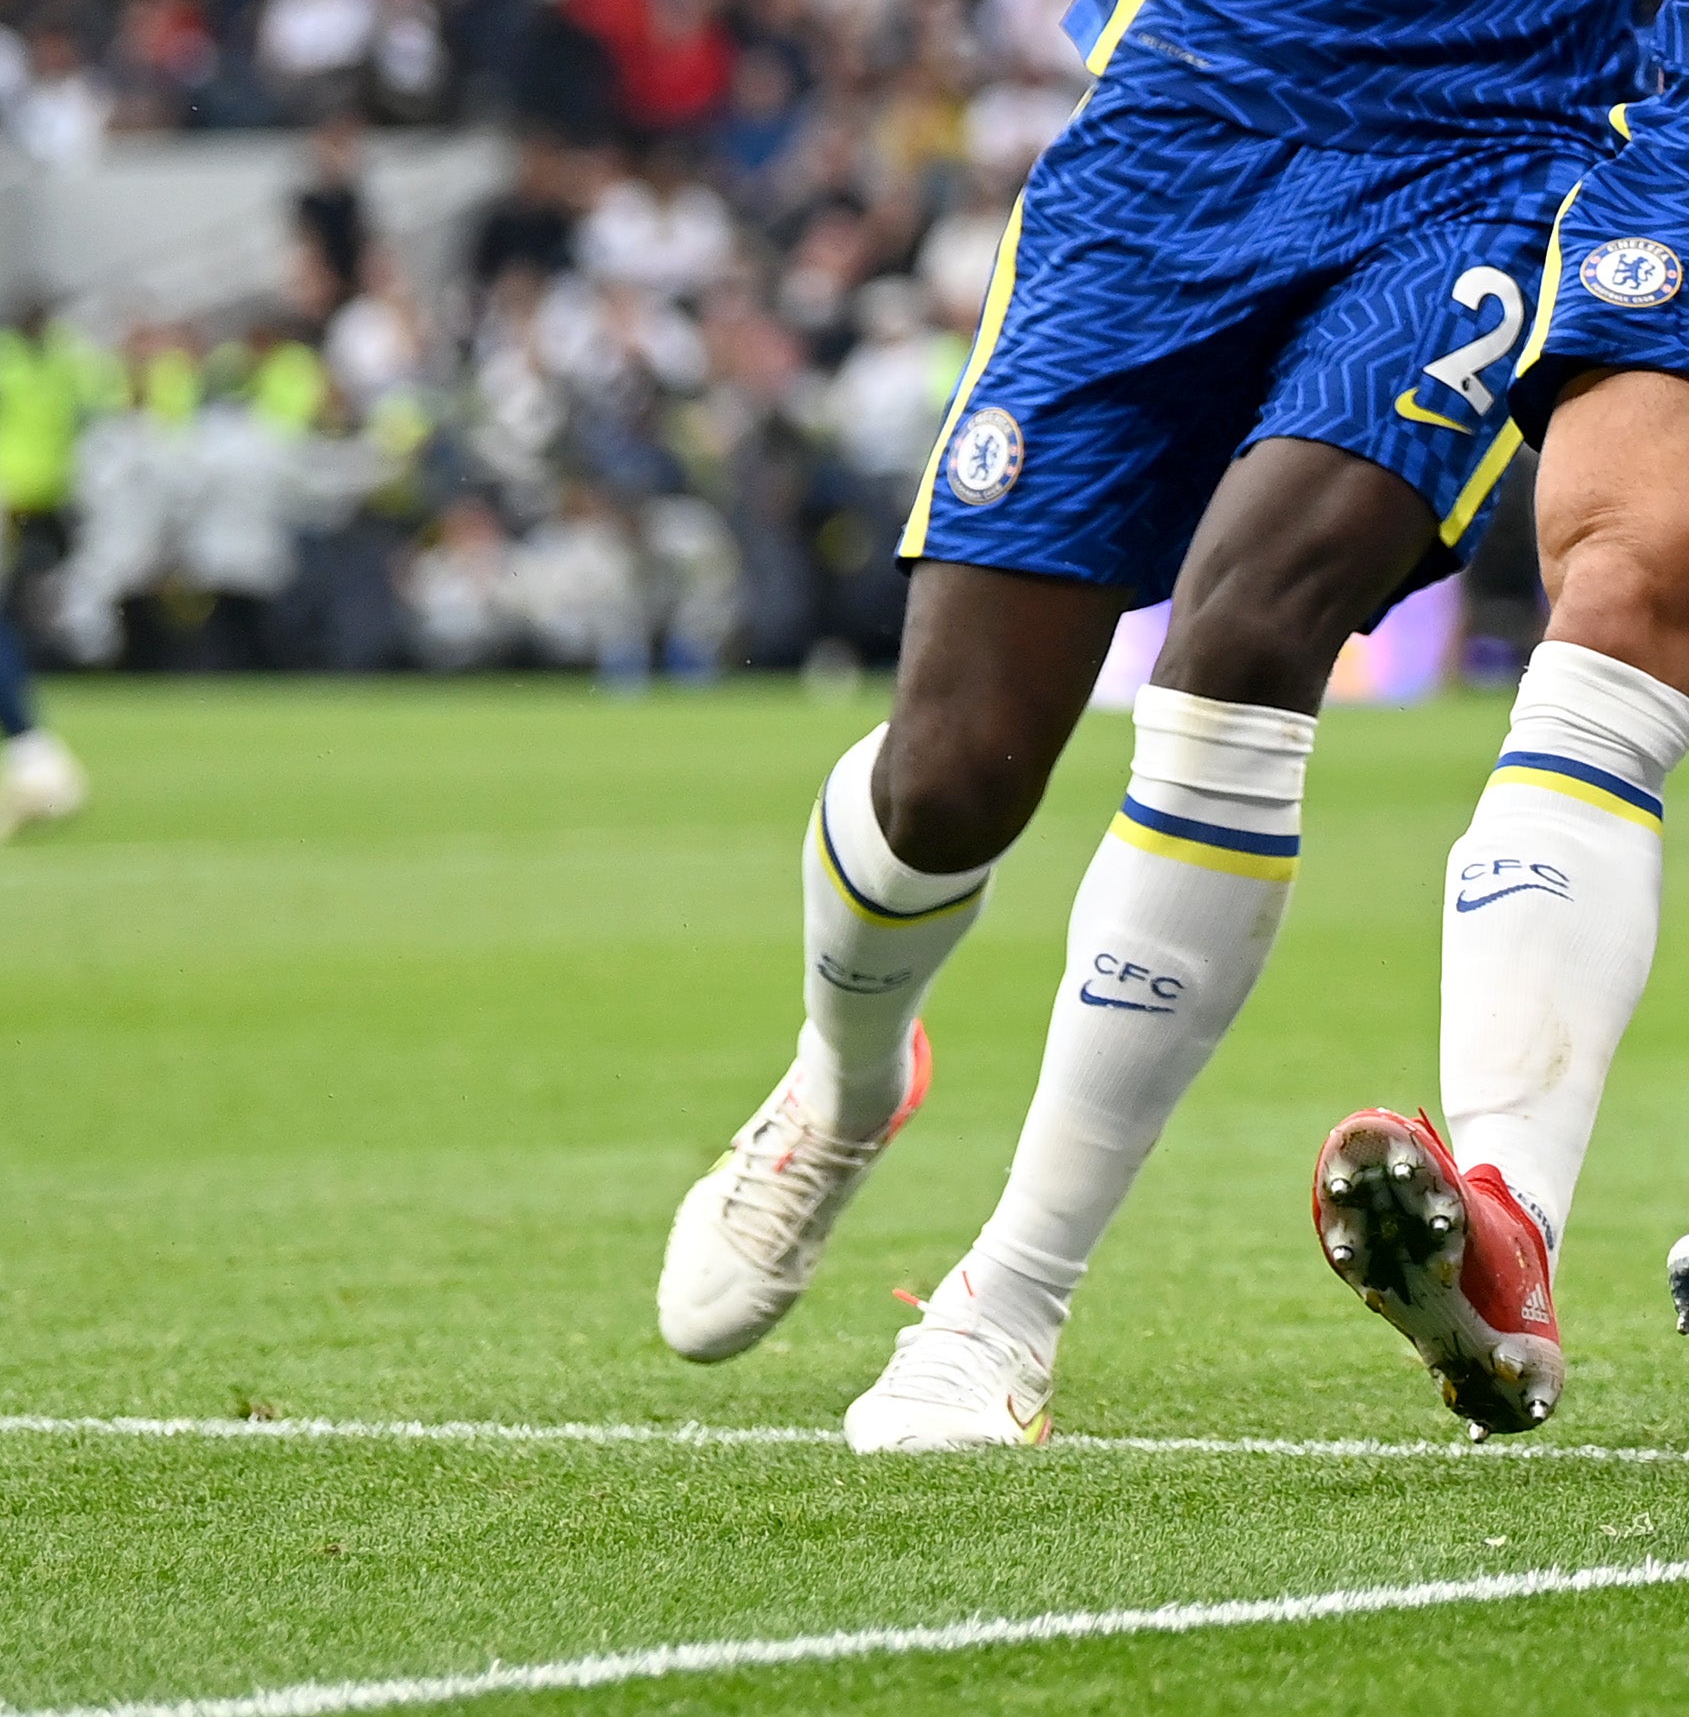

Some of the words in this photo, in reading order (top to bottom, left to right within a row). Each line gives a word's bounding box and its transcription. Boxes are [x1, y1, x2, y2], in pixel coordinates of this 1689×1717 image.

[1423, 266, 1524, 416] 2
[1462, 859, 1570, 889] CFC
[1095, 954, 1184, 999] CFC
